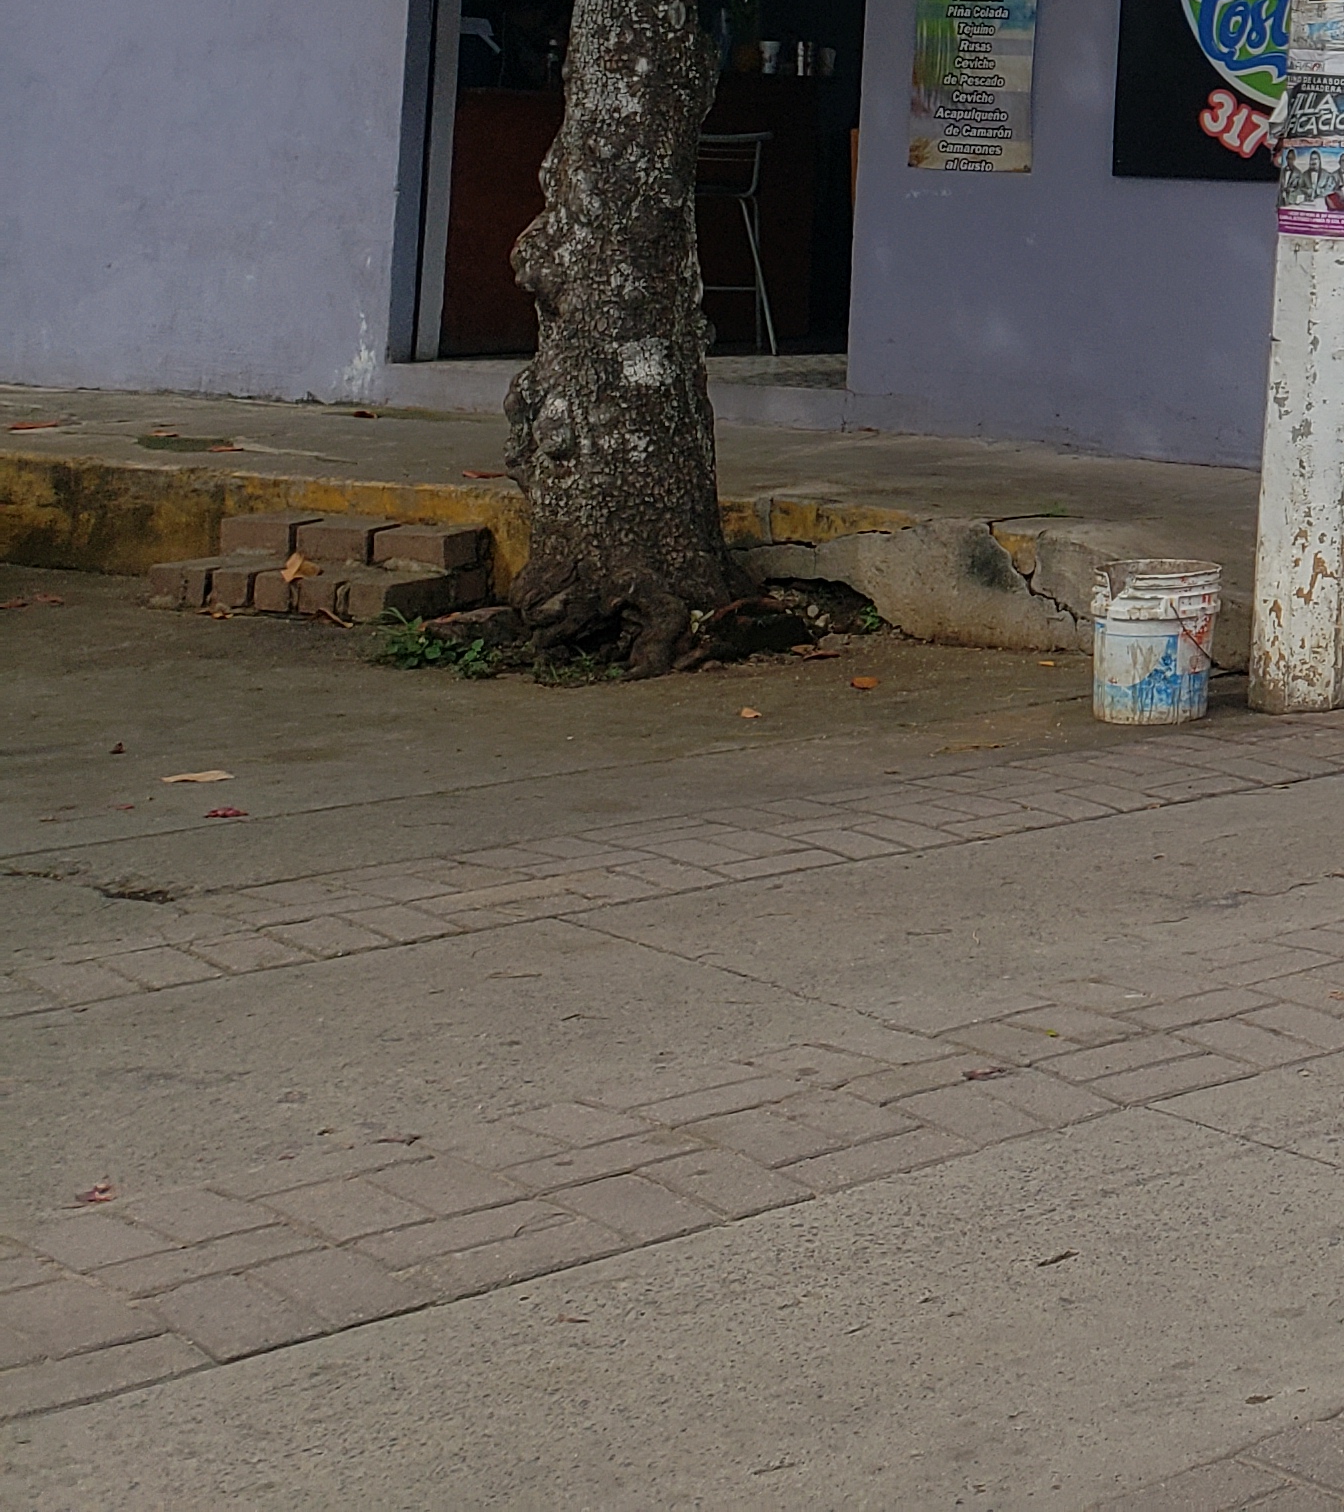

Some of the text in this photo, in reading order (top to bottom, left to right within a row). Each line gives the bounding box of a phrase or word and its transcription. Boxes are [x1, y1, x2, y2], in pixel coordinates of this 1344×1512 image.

[973, 6, 1009, 18] Colada
[958, 23, 995, 36] Tejuino
[959, 40, 992, 51] Rusas
[954, 57, 996, 69] Ceviche
[943, 74, 1005, 87] de Pescado
[952, 90, 994, 103] Ceviche
[935, 107, 1008, 122] Acapulqueño
[1202, 90, 1269, 156] 317
[945, 124, 1012, 139] de Camarón
[938, 141, 1002, 155] Camarones
[945, 159, 993, 172] al Gusto
